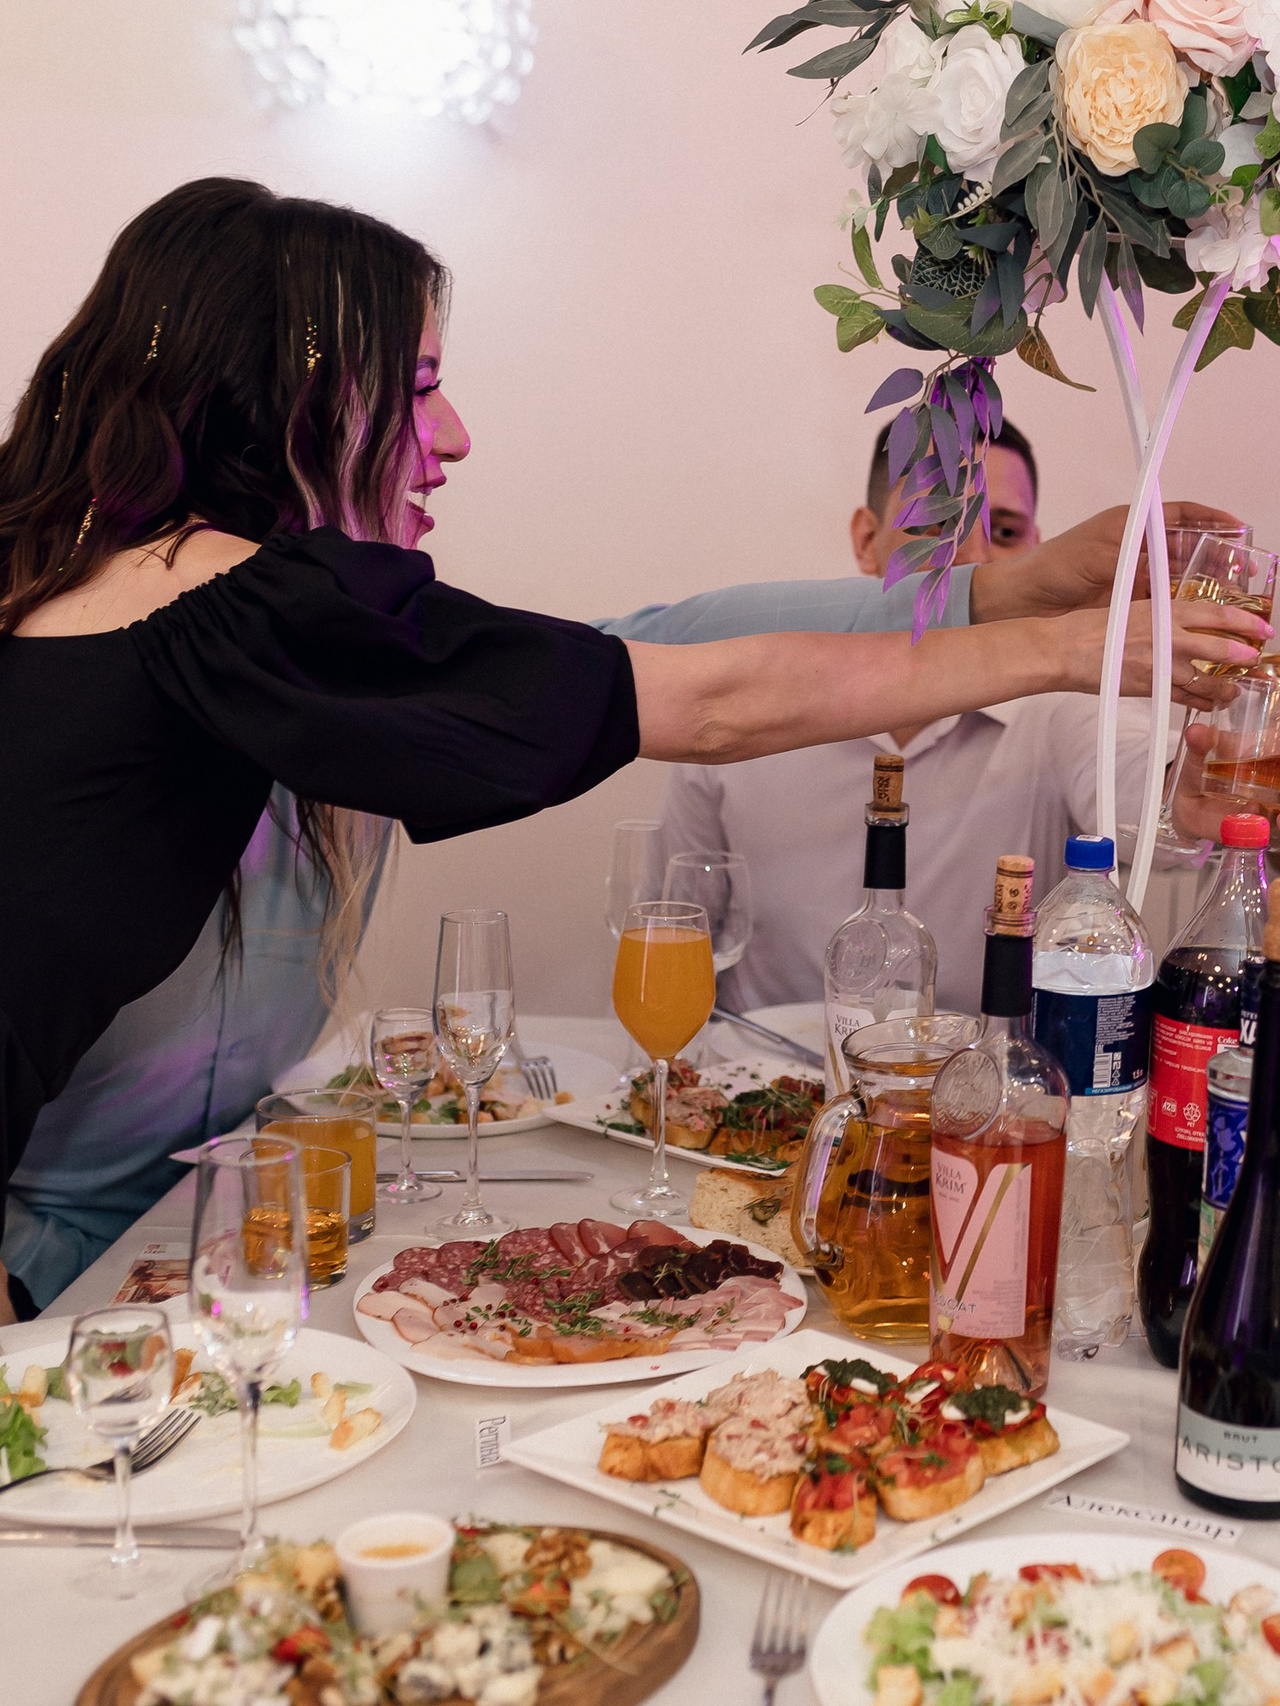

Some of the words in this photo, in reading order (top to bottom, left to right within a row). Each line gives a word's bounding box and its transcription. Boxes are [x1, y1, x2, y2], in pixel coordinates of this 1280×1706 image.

[836, 1014, 860, 1028] VILLA
[834, 1023, 857, 1036] KRI
[937, 1162, 961, 1181] VILLA
[935, 1173, 967, 1194] KRIM
[1223, 1430, 1259, 1444] BRUT
